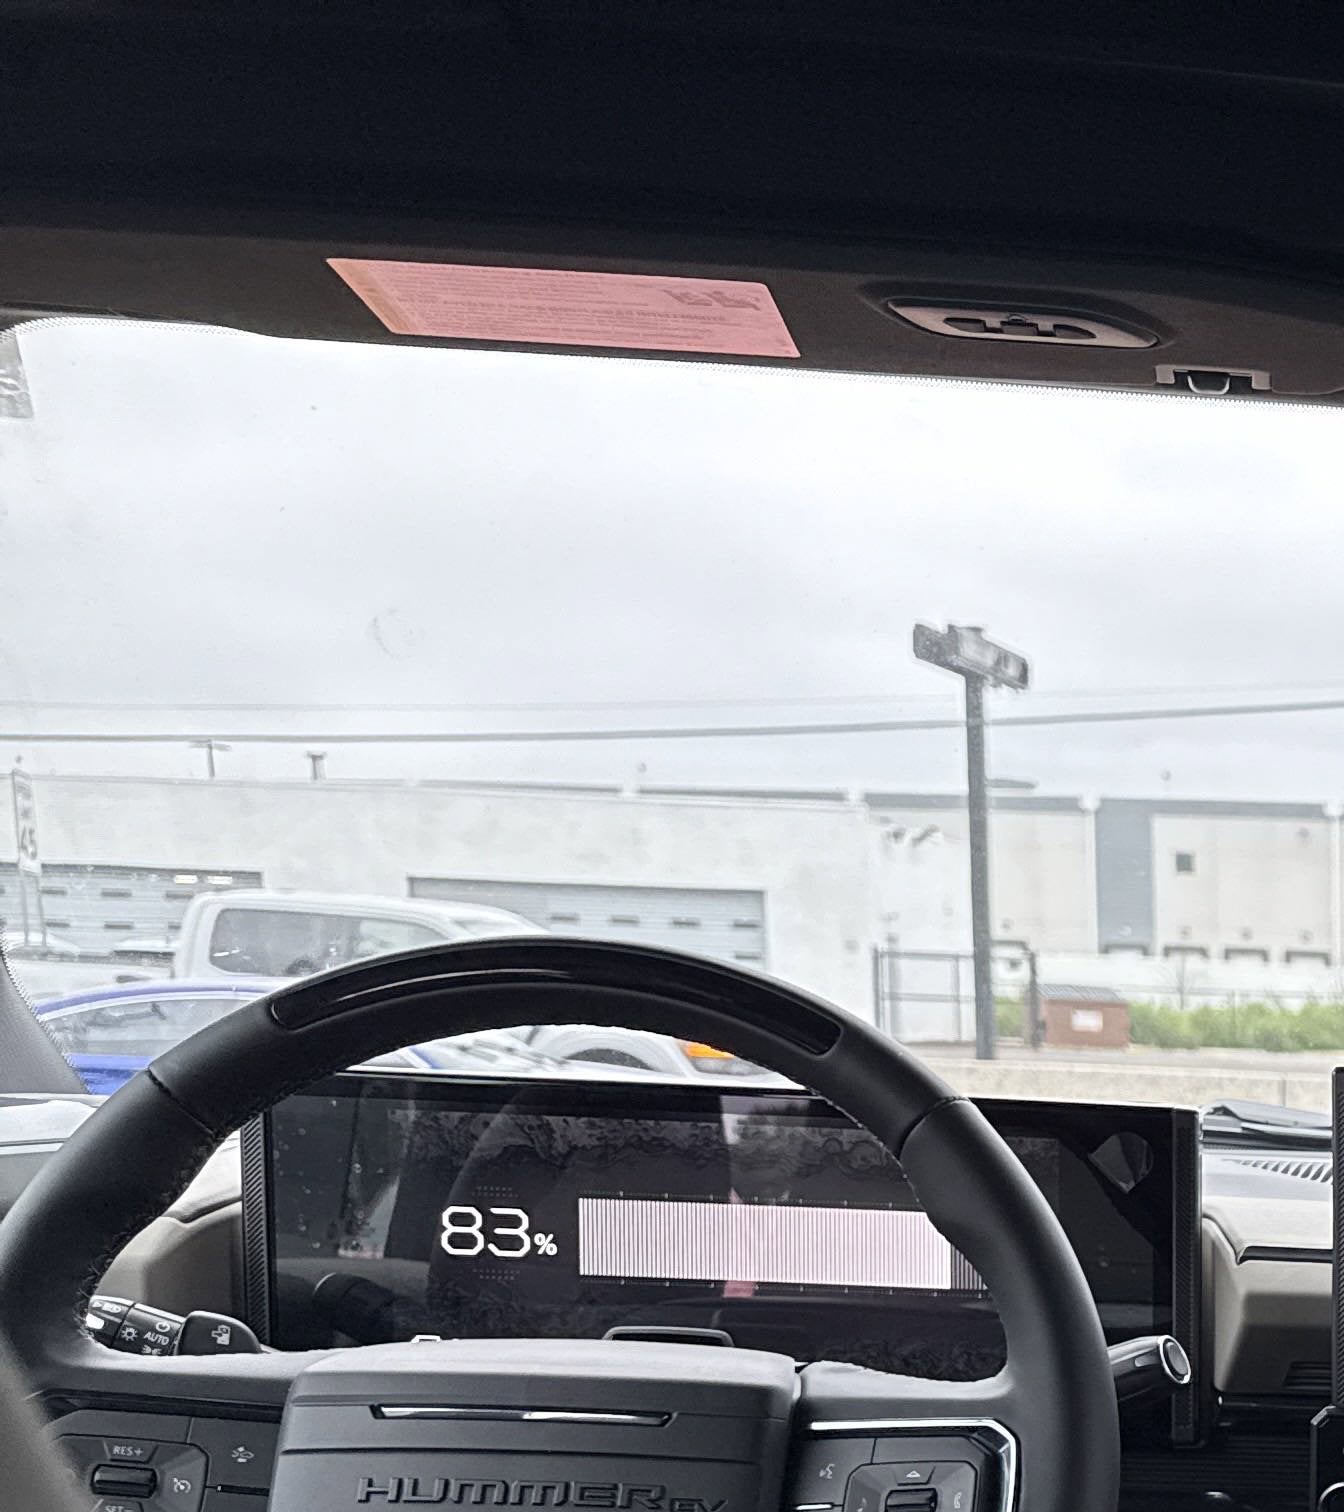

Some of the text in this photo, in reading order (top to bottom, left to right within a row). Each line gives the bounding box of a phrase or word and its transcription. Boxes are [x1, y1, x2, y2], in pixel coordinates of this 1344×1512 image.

[440, 1205, 558, 1258] 83%
[143, 1331, 170, 1345] AUTO
[356, 1477, 667, 1511] HUMMER
